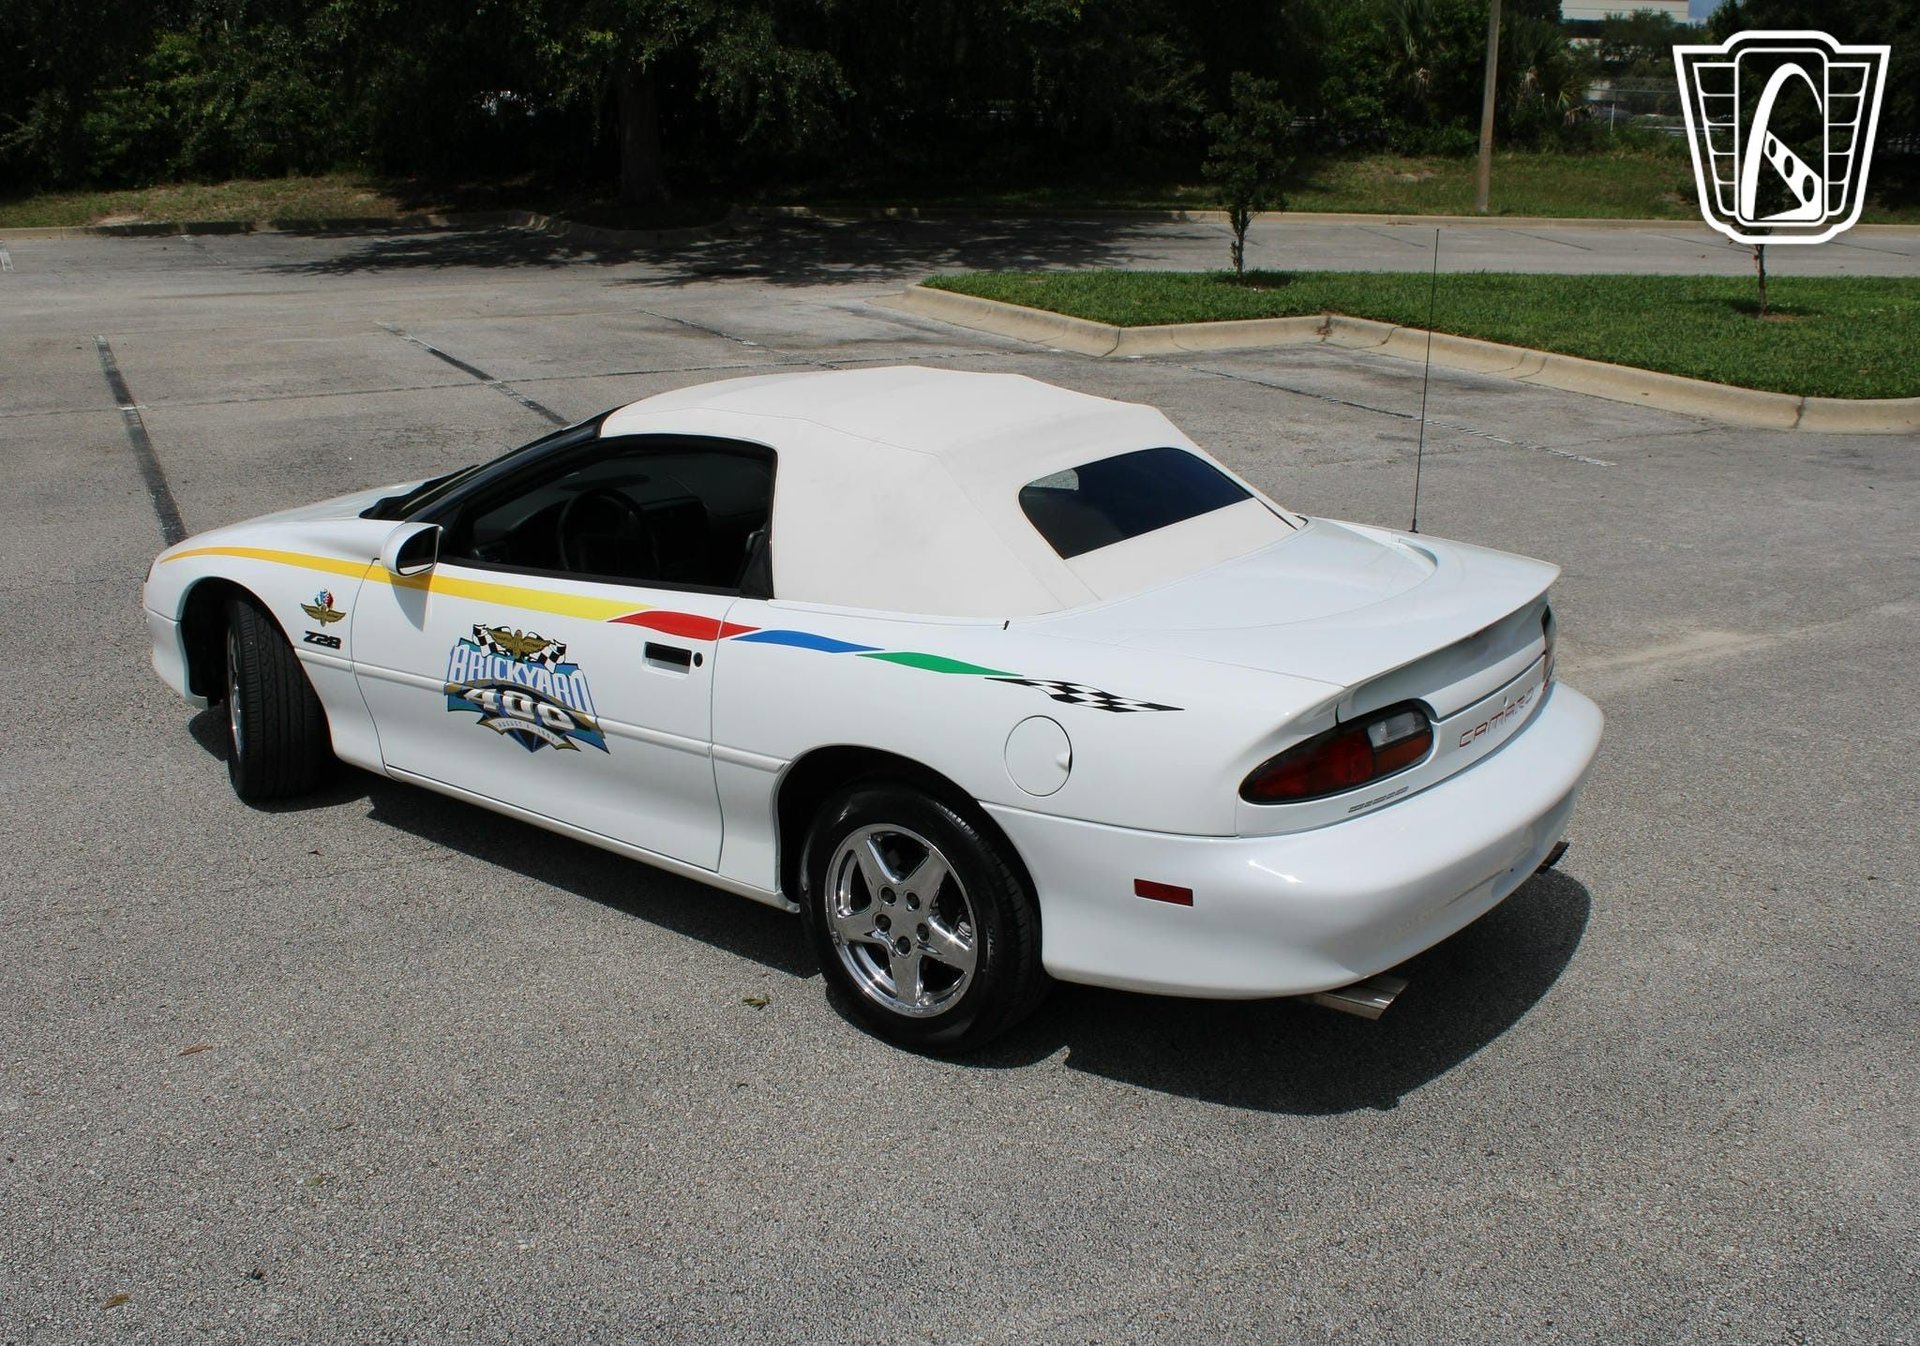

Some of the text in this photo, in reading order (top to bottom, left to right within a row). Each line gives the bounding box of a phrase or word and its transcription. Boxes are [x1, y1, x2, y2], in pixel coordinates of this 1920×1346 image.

[303, 630, 341, 650] Z28
[449, 644, 597, 717] BRICKYARD
[463, 688, 576, 732] 400
[1459, 687, 1535, 748] CAMARO
